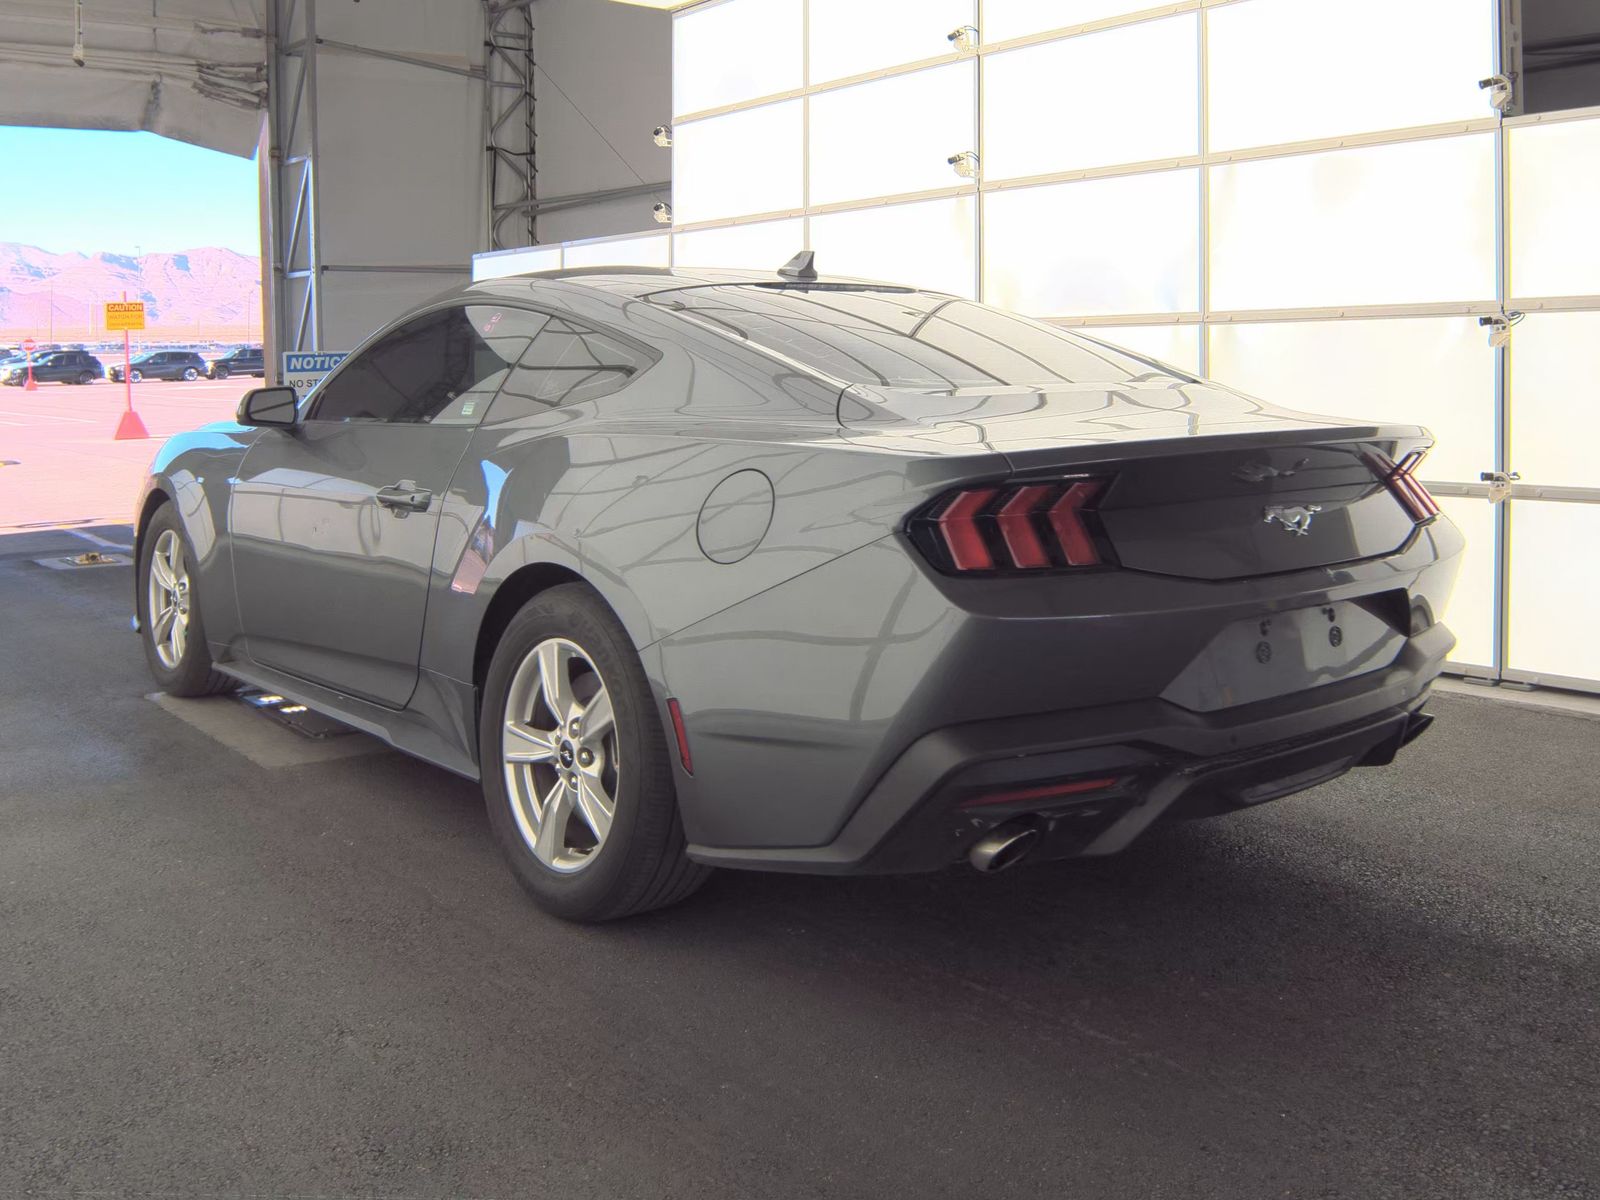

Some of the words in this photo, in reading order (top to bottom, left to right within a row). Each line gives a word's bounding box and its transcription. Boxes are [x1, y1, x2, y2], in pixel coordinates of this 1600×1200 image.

[290, 356, 348, 369] NOTIC
[289, 379, 304, 388] NO
[306, 379, 322, 388] ST
